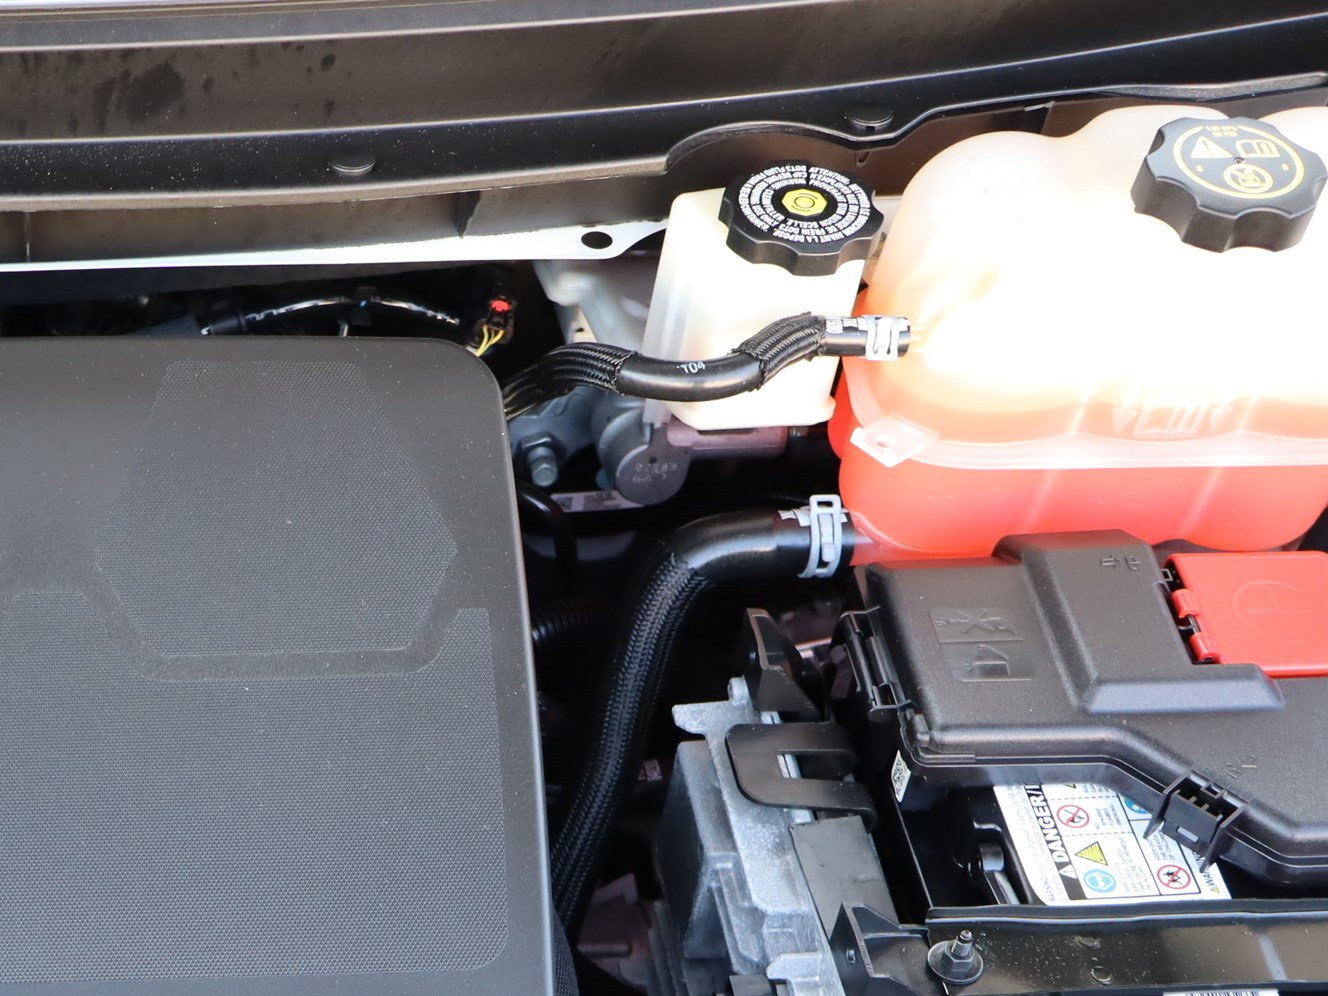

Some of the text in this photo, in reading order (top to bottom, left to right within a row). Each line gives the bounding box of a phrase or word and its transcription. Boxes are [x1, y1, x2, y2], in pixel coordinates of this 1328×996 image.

[752, 205, 765, 217] USE
[760, 214, 779, 227] ONLY
[825, 225, 839, 233] DE
